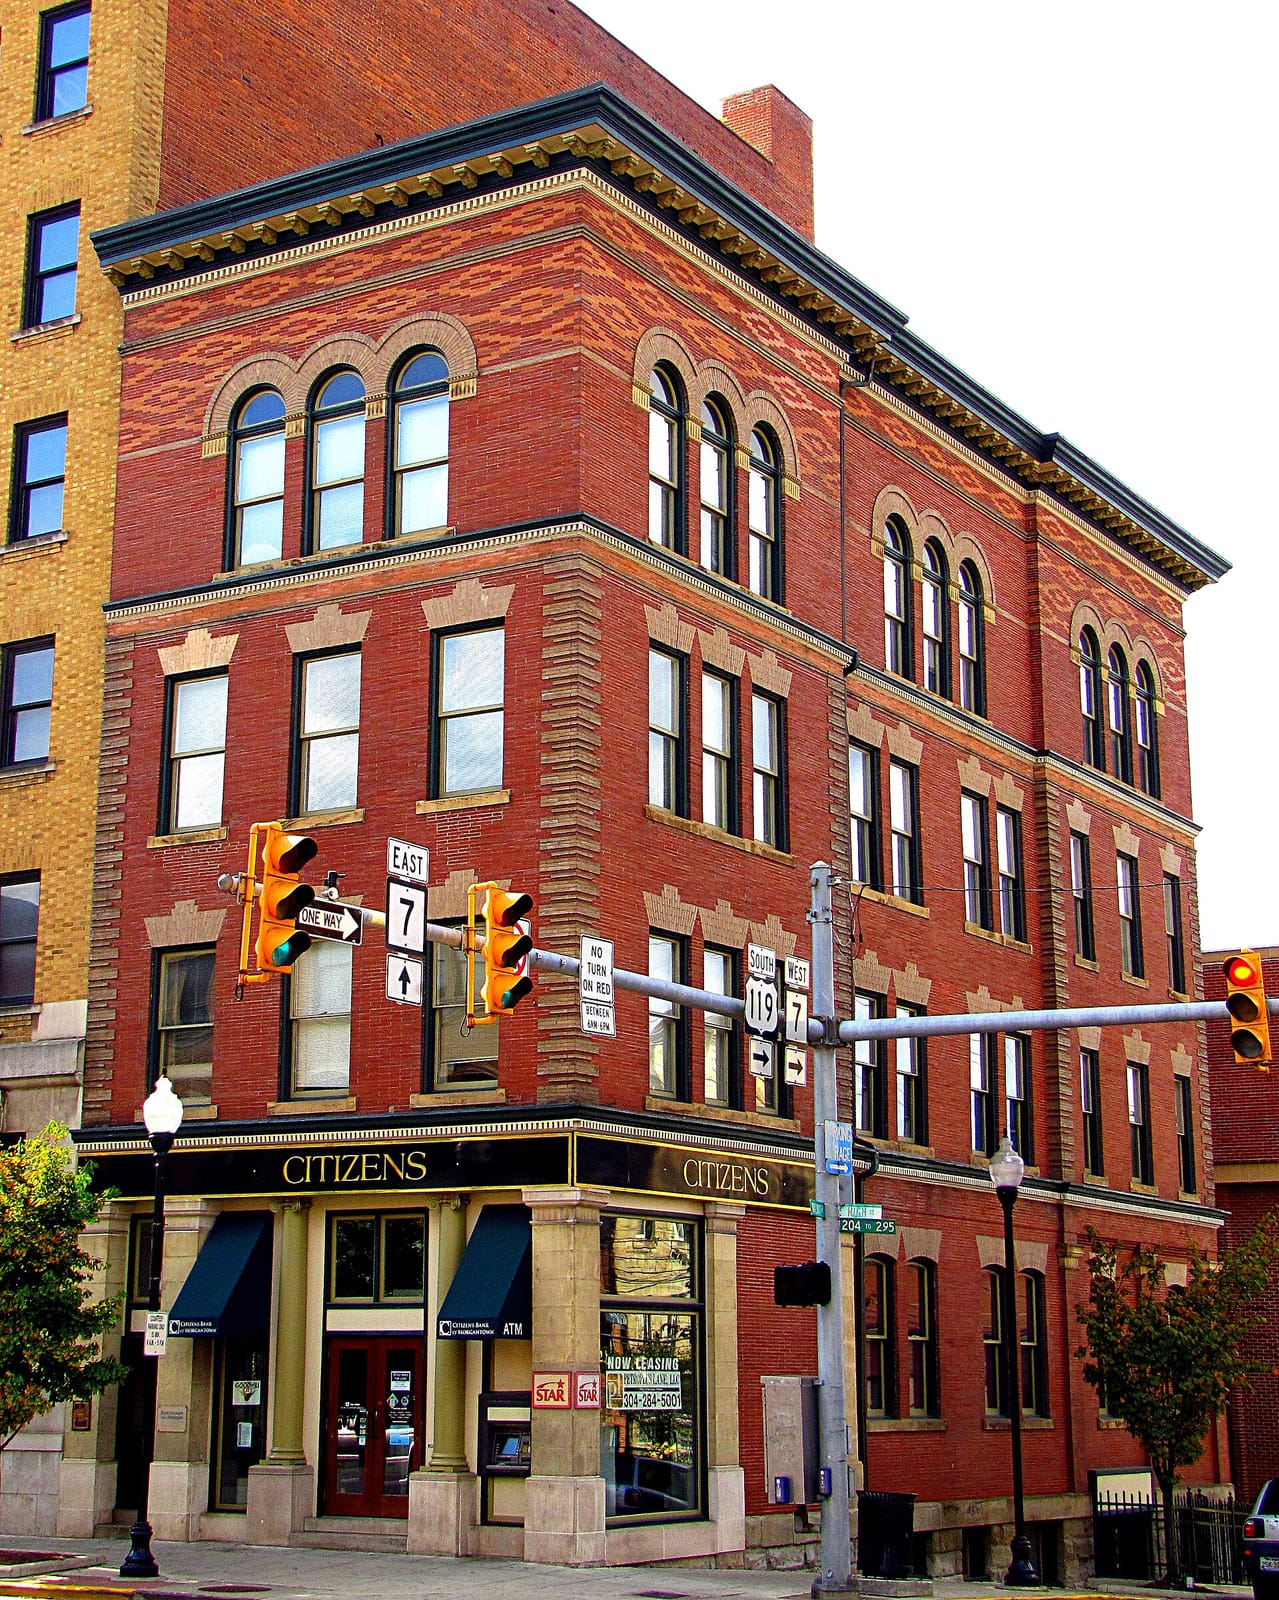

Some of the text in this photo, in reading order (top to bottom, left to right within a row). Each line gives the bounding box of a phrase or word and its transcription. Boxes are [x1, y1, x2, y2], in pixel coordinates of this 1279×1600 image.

[393, 846, 423, 875] EAST
[301, 907, 343, 929] ONE WAY
[400, 897, 415, 936] 7
[591, 945, 603, 959] NO
[750, 949, 774, 973] SOUTH
[587, 962, 607, 977] TURN
[788, 961, 807, 983] WEST
[583, 979, 611, 995] ON RED
[586, 1006, 610, 1018] BETWEEN
[750, 988, 773, 1022] 119
[792, 1001, 802, 1032] 7
[283, 1151, 427, 1185] CITIZENS
[683, 1159, 769, 1195] CITIZENS
[841, 1219, 861, 1231] 204
[876, 1221, 895, 1232] 295
[503, 1322, 523, 1335] ATM
[607, 1356, 679, 1370] NOW LEASING
[536, 1388, 566, 1401] STAR
[578, 1389, 598, 1402] STAR
[624, 1393, 680, 1407] 304-284-5001
